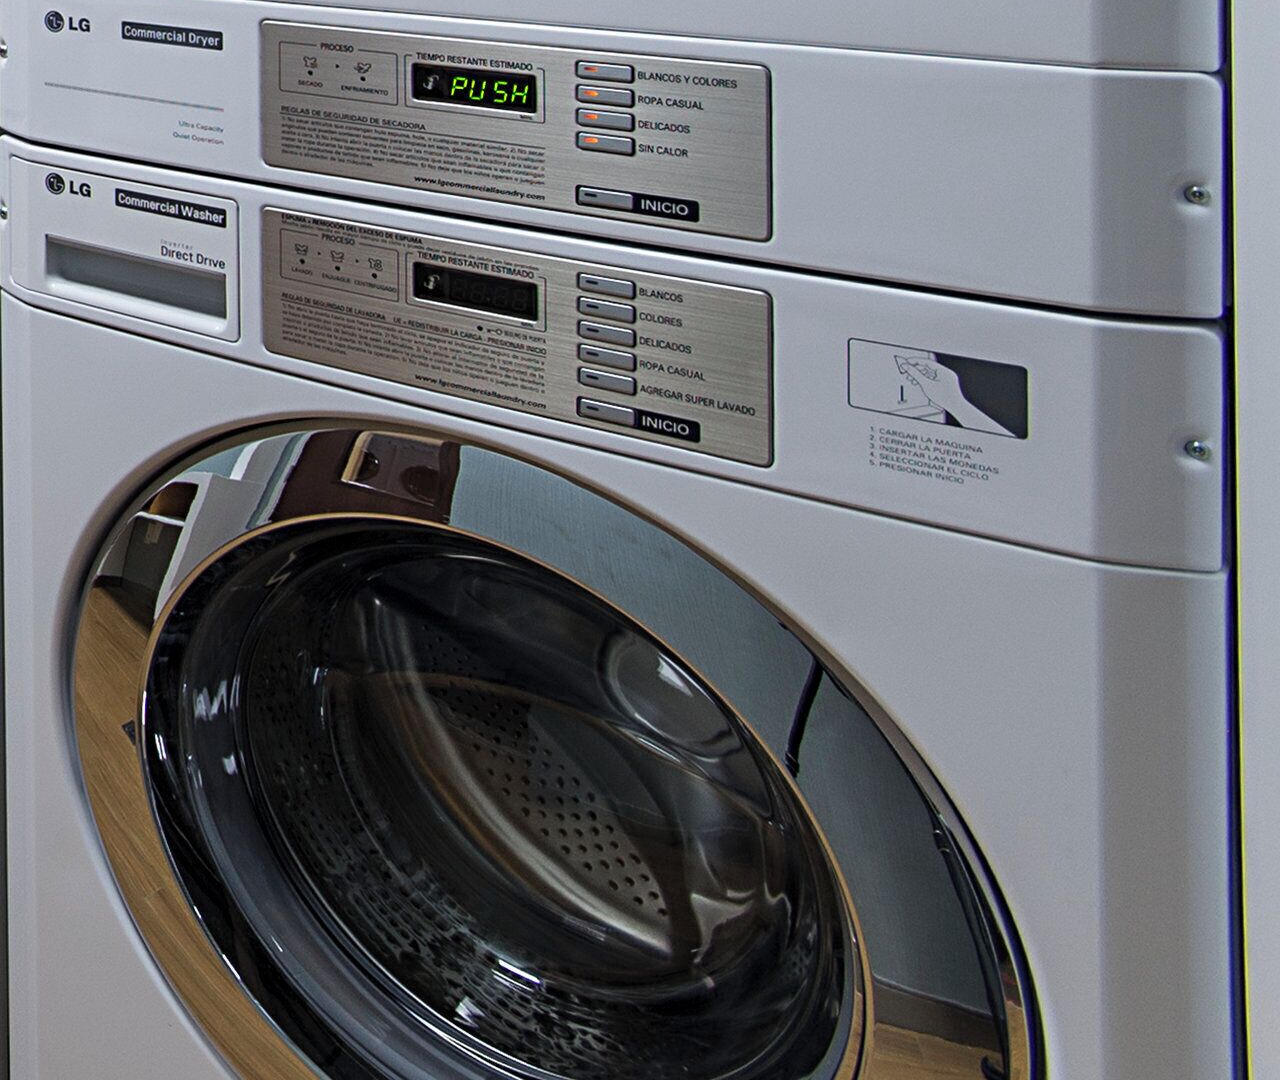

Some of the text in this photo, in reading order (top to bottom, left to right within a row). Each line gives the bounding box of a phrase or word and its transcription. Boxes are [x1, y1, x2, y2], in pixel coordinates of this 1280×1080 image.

[68, 17, 91, 33] LG
[123, 25, 220, 48] Commercial Dryer
[320, 42, 354, 53] PROCESO
[416, 52, 533, 71] TIEMPO RESTANTE ESTIMADO
[450, 76, 529, 104] PUSH
[637, 71, 738, 89] BLANCOS Y COLORES
[637, 95, 704, 111] ROPA CASUAL
[637, 119, 691, 134] DELICADOS
[638, 144, 689, 157] SIN CALOR
[69, 180, 92, 198] LG
[117, 192, 225, 224] Commercial Washer
[640, 198, 689, 216] INICIO
[321, 233, 355, 246] PROCESO
[160, 245, 226, 270] Direct Drive
[417, 251, 535, 279] TIEMPO RESTANTE ESTIMADO
[639, 288, 684, 303] BLANCOS
[639, 312, 683, 327] COLORES
[639, 336, 692, 354] DELICADOS
[639, 359, 706, 381] ROPA CASUAL
[639, 384, 756, 417] AGREGAR SUPER LAVADO
[641, 415, 690, 436] INICIO
[879, 427, 919, 441] CARGAR
[920, 434, 933, 444] LA
[935, 438, 983, 454] MAQUINA
[879, 436, 916, 450] CERRAR
[918, 444, 931, 453] LA
[933, 446, 971, 460] PUERTA
[879, 444, 926, 459] INSERTAR
[927, 454, 947, 464] LAS
[949, 458, 1000, 475] MONEDAS
[879, 452, 945, 472] SELECCIONAR
[946, 467, 957, 475] EL
[961, 469, 990, 481] CICLO
[879, 461, 933, 478] PRESIONAR
[935, 473, 965, 485] INICIO
